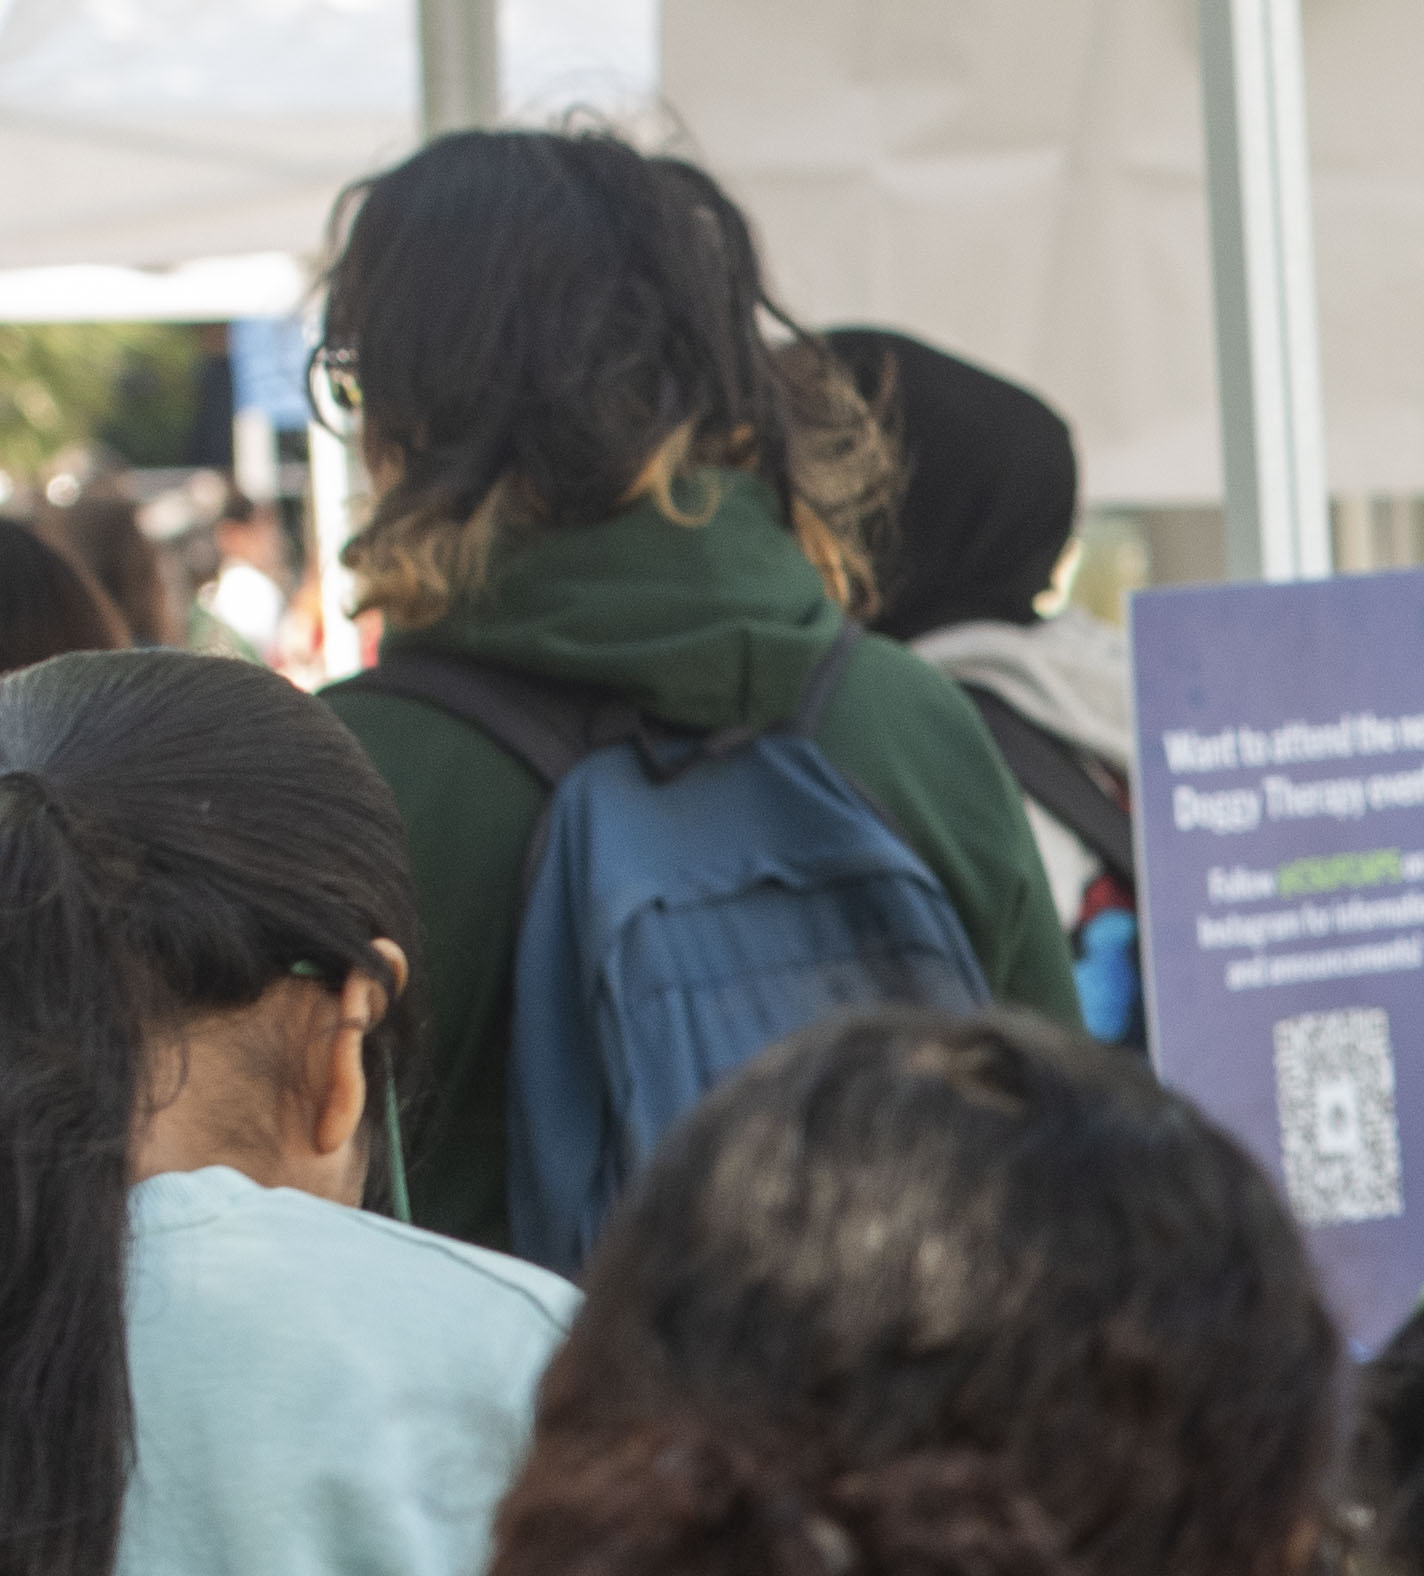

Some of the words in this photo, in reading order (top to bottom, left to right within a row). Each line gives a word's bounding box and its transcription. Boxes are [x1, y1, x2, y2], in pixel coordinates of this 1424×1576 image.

[1163, 727, 1237, 774] Want
[1238, 724, 1268, 769] to
[1173, 783, 1261, 835] Doggy
[1262, 774, 1366, 822] Therapy
